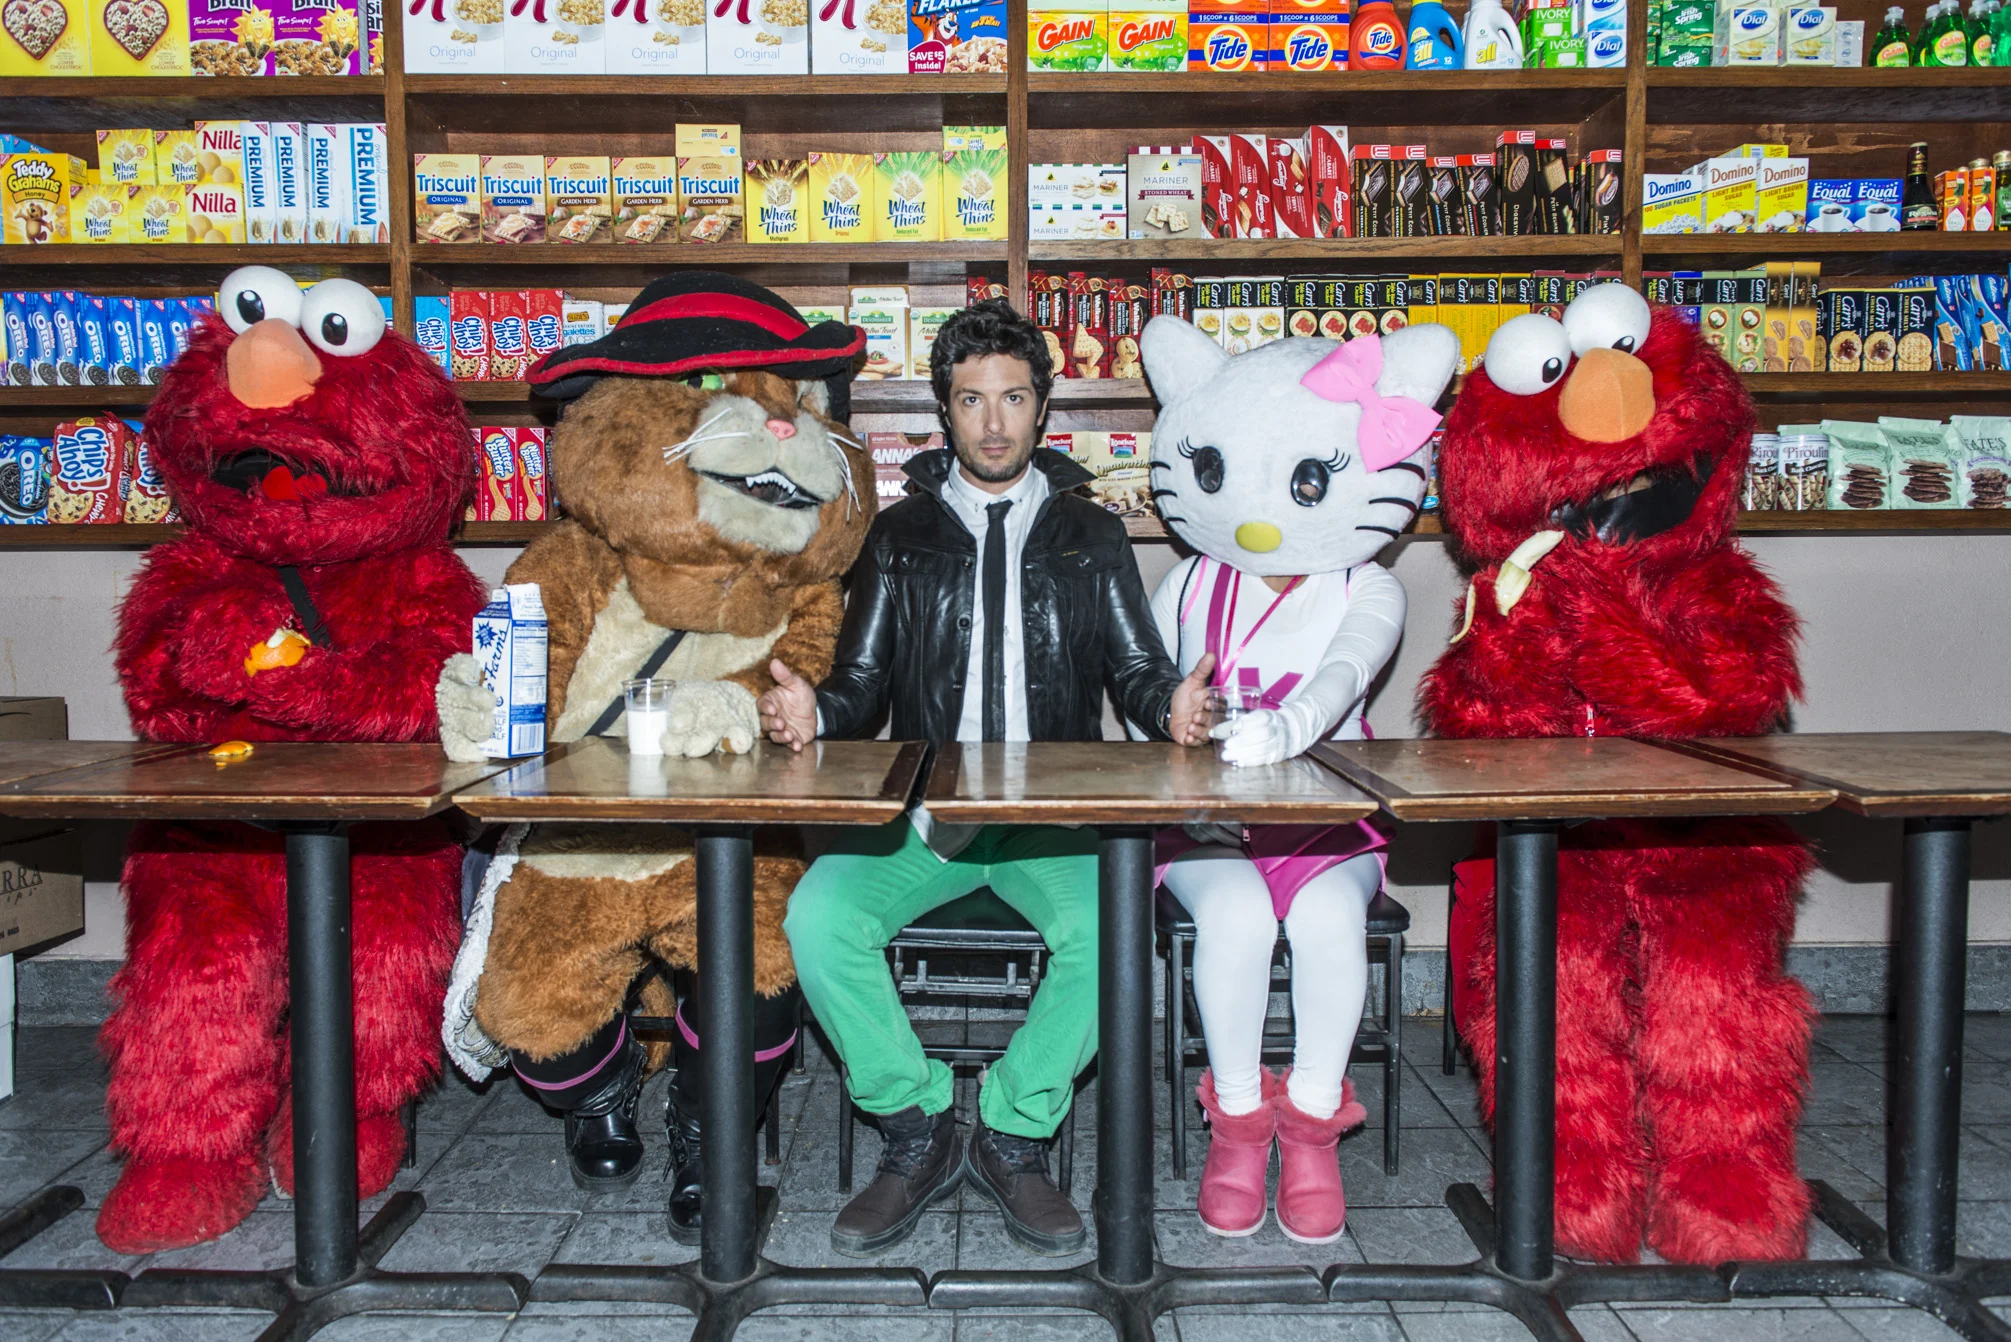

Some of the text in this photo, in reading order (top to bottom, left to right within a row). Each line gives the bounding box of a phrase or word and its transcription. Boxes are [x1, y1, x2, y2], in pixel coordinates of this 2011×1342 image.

[1536, 9, 1570, 20] IVORY
[1675, 12, 1702, 25] Spring
[1681, 7, 1698, 16] Irish
[1743, 14, 1766, 24] Dial
[1800, 14, 1822, 24] Dial
[1037, 19, 1095, 52] GAIN
[1118, 19, 1176, 52] GAIN
[1369, 31, 1392, 48] Tide
[1550, 39, 1584, 49] IVORY
[429, 45, 476, 60] Original
[530, 46, 577, 61] Original
[631, 47, 678, 61] Original
[734, 48, 780, 61] Original
[1209, 37, 1248, 66] Tide
[1289, 37, 1328, 66] Tide
[1414, 42, 1433, 62] all
[1476, 43, 1497, 64] all
[1596, 40, 1621, 51] Dial
[839, 52, 885, 68] Original
[909, 51, 944, 61] SAVE $5
[1678, 53, 1695, 62] Irish
[202, 130, 241, 150] Nilla
[12, 160, 55, 178] Teddy
[112, 171, 138, 181] Thins
[113, 162, 138, 172] Wheat
[172, 162, 197, 172] Wheat
[248, 136, 265, 208] PREMIUM
[279, 136, 296, 208] PREMIUM
[315, 137, 329, 208] PREMIUM
[356, 127, 377, 226] PREMIUM
[1711, 165, 1753, 184] Domino
[1763, 165, 1806, 184] Domino
[8, 175, 61, 192] Grahams
[416, 174, 476, 193] Triscuit
[483, 176, 542, 194] Triscuit
[548, 176, 607, 194] Triscuit
[615, 176, 673, 194] Triscuit
[680, 176, 740, 194] Triscuit
[1648, 179, 1692, 198] Domino
[1712, 183, 1752, 198] LIGHT BROWN
[1765, 183, 1803, 198] LIGHT BROWN
[192, 193, 237, 213] Nilla
[957, 196, 995, 213] Wheat
[1654, 200, 1673, 211] SUGAR
[1673, 195, 1696, 206] PACKETS
[1724, 192, 1742, 201] SUGAR
[1777, 191, 1794, 201] SUGAR
[760, 206, 797, 222] Wheat
[822, 199, 861, 216] Wheat
[888, 198, 926, 215] Wheat
[85, 217, 112, 228] Wheat
[143, 217, 169, 228] Wheat
[759, 220, 798, 235] Thins
[821, 214, 861, 230] Thins
[887, 213, 926, 228] Thins
[956, 212, 995, 226] Thins
[85, 227, 112, 238] Thins
[142, 227, 170, 238] Thins
[1211, 283, 1221, 307] Carr's
[1242, 283, 1252, 307] Carr's
[1271, 282, 1281, 306] Carr's
[1305, 282, 1315, 307] Carr's
[1336, 282, 1346, 307] Carr's
[1365, 282, 1375, 307] Carr's
[1396, 281, 1406, 306] Carr's
[1426, 280, 1435, 304] Carr's
[1458, 279, 1468, 303] Carr's
[1488, 279, 1497, 303] Carr's
[1520, 279, 1529, 303] Carr's
[1841, 295, 1855, 329] Carr's
[1875, 295, 1889, 329] Carr's
[1910, 295, 1925, 329] Carr's
[9, 314, 24, 357] OREO
[36, 314, 51, 357] OREO
[58, 313, 72, 356] OREO
[427, 318, 443, 345] Chips
[464, 316, 482, 348] Chips
[504, 316, 521, 348] Chips
[539, 315, 558, 347] Chips
[563, 328, 595, 336] galettes
[85, 321, 101, 363] OREO
[114, 321, 132, 363] OREO
[145, 321, 163, 364] OREO
[1891, 435, 1942, 446] TATE'S
[1964, 437, 2006, 451] TATE'S
[76, 428, 110, 478] Chips
[485, 443, 505, 477] Butter
[496, 437, 514, 473] Nutter
[520, 449, 535, 476] Butter
[528, 445, 542, 473] Nutter
[20, 450, 35, 505] OREO
